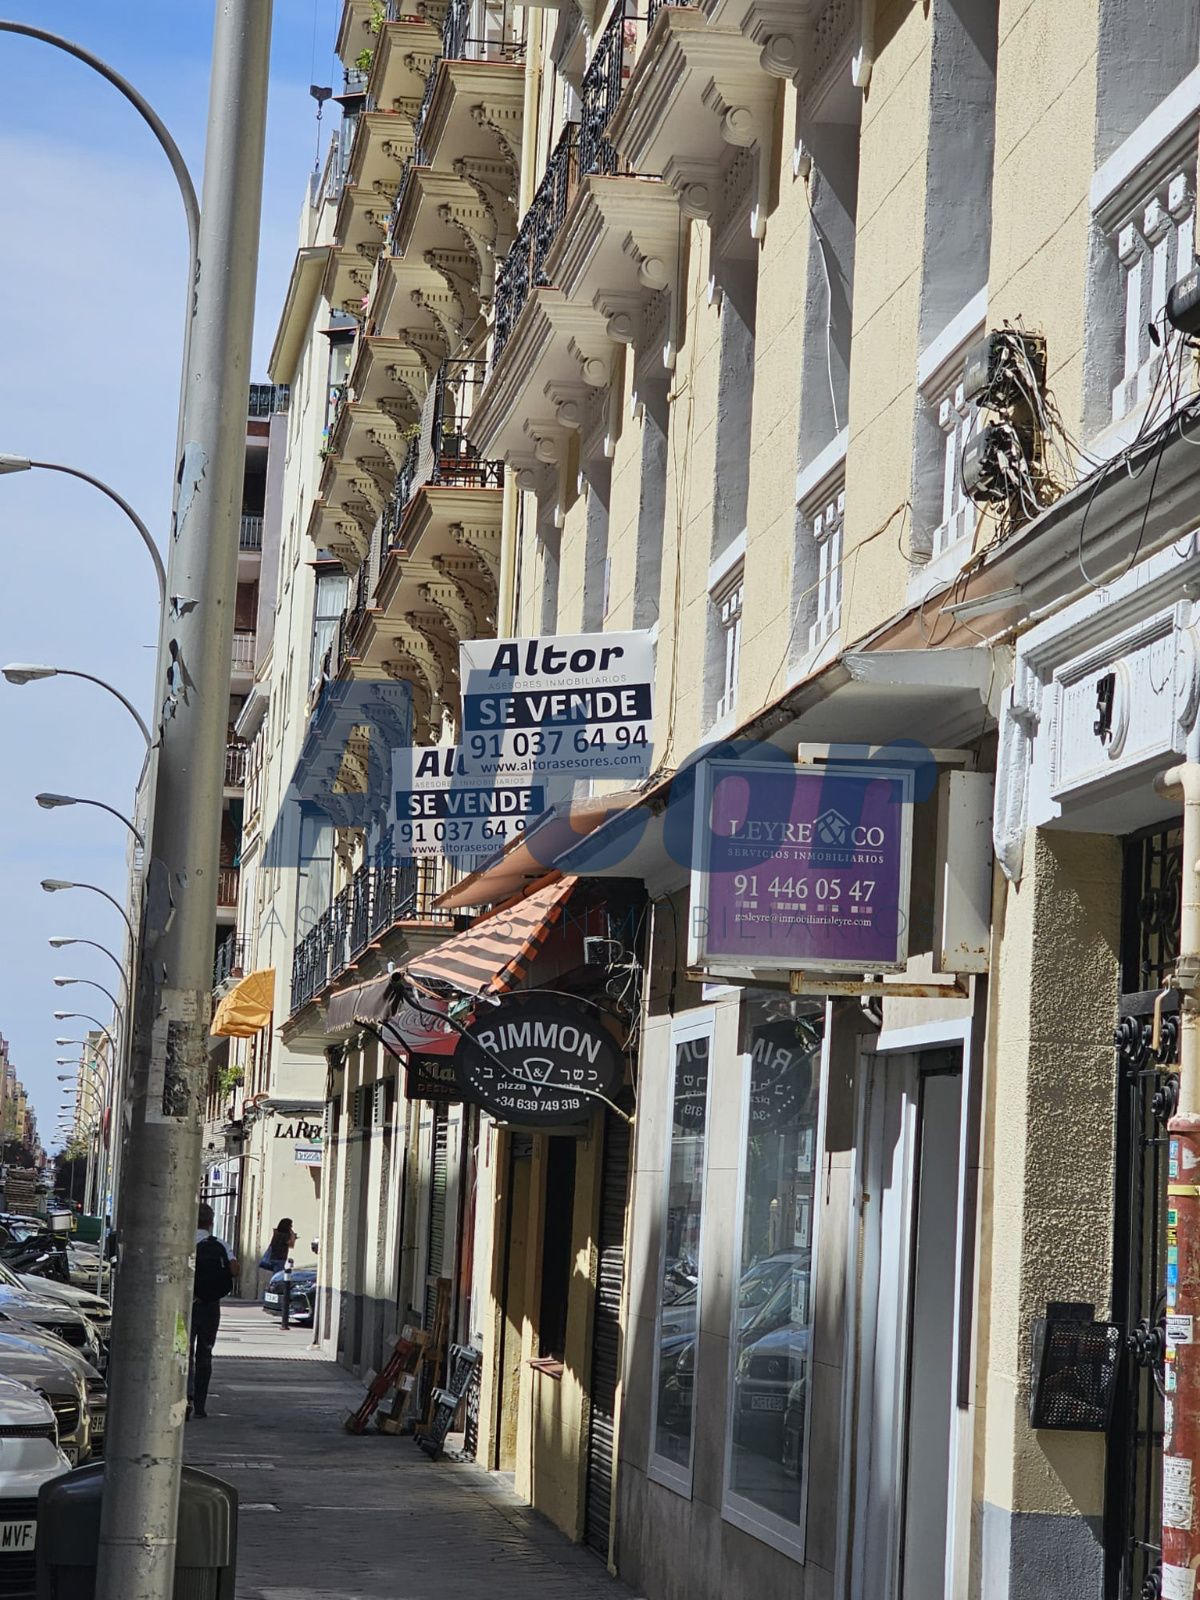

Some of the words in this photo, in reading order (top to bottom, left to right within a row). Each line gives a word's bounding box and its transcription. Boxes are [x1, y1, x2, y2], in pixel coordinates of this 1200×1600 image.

[489, 640, 625, 677] Altor
[488, 680, 542, 690] ASESORES
[546, 675, 627, 688] INMOBILIARIOS
[479, 696, 516, 725] SE
[525, 690, 638, 722] VENDE
[470, 733, 503, 759] 91
[513, 730, 563, 757] 037
[573, 728, 606, 753] 64
[615, 725, 649, 751] 94
[481, 753, 642, 773] www.altorasesores.com
[408, 794, 437, 816] SE
[444, 790, 533, 814] VENDE
[401, 823, 427, 843] 91
[434, 821, 473, 842] 037
[482, 820, 508, 840] 64
[729, 819, 813, 843] LEYRE
[851, 826, 885, 847] CO
[409, 842, 504, 855] www.altorasesore
[728, 847, 789, 859] SERVICIOS
[794, 851, 884, 864] INMOBILIARIOS
[734, 874, 759, 896] 91
[768, 876, 808, 899] 446
[815, 878, 841, 900] 05
[849, 880, 876, 902] 47
[477, 1021, 602, 1064] RIMMON
[497, 1081, 527, 1091] pizza
[560, 1069, 598, 1081] כשר
[495, 1096, 514, 1107] +34
[517, 1098, 538, 1111] 639
[540, 1100, 559, 1112] 749
[561, 1098, 580, 1110] 319
[2, 1524, 32, 1547] MVF
